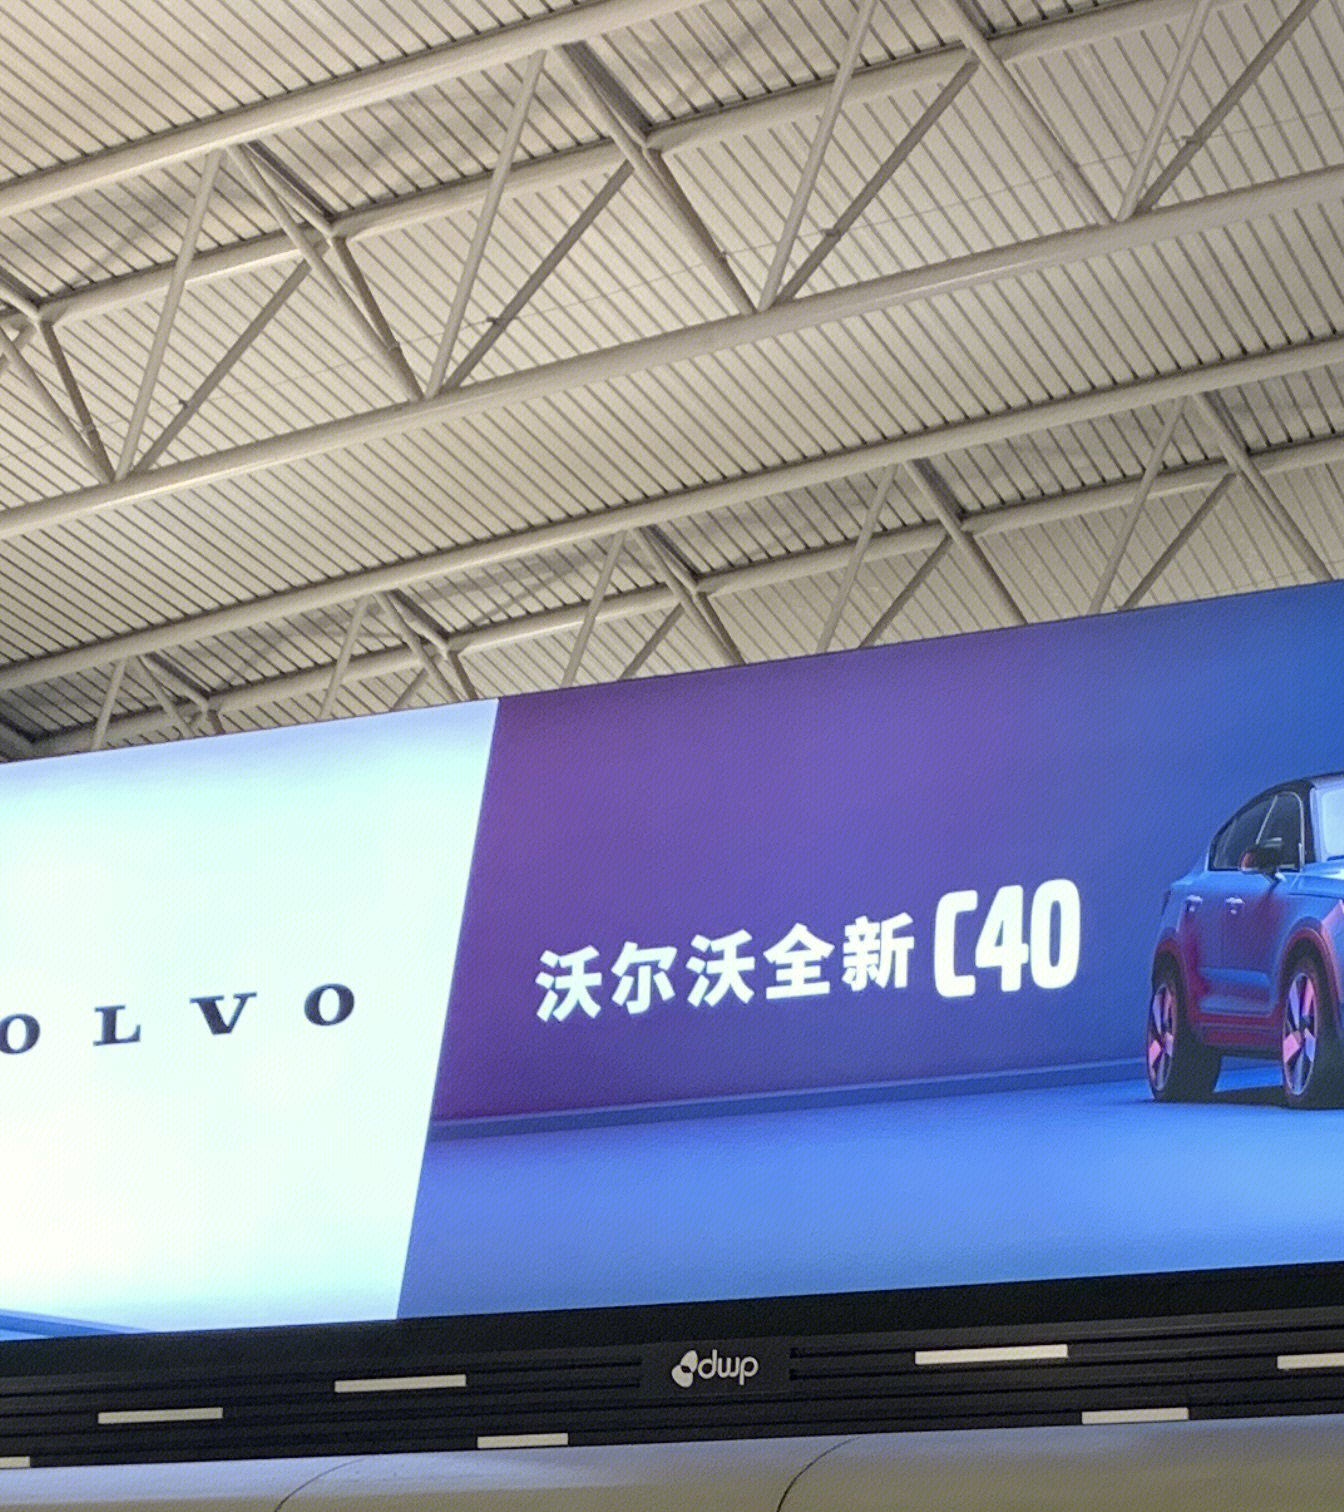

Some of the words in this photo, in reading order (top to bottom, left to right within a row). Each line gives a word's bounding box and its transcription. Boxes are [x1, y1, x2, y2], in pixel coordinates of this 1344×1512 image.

[535, 912, 916, 1023] 沃尔沃全新
[933, 878, 1081, 998] C40
[698, 1349, 759, 1386] dwp
